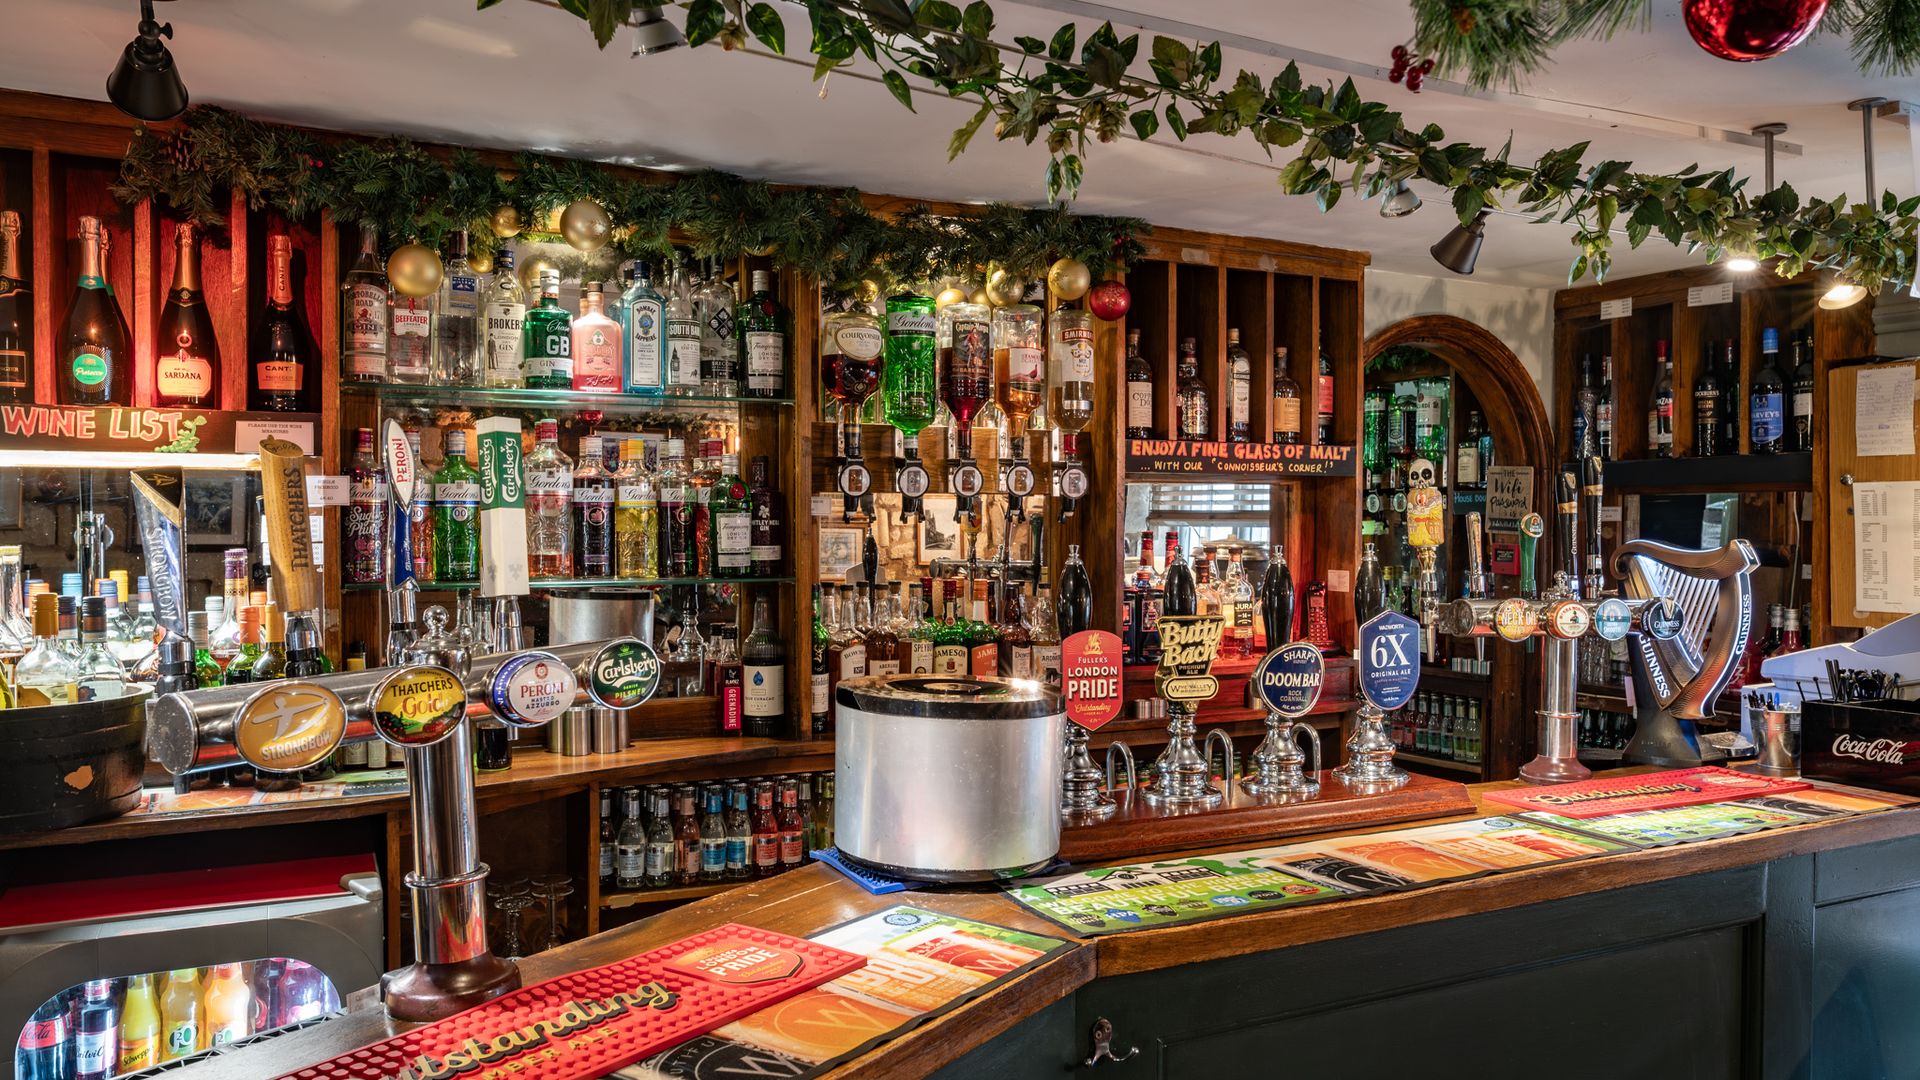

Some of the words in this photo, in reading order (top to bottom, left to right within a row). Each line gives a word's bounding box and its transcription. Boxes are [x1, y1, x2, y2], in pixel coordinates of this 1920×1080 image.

[395, 314, 428, 324] BEEFEATER
[894, 315, 935, 329] Gordon's
[669, 324, 690, 336] SOUTH
[546, 335, 570, 356] GB
[540, 358, 556, 367] GIN
[164, 371, 202, 380] SARDANA
[2, 405, 97, 438] WINE
[109, 408, 183, 442] LIST
[392, 438, 408, 484] PERONI
[1131, 440, 1177, 457] ENJOY
[1176, 441, 1188, 457] A
[1191, 441, 1228, 459] FINE
[1234, 444, 1281, 460] GLASS
[1284, 445, 1304, 460] OF
[1310, 445, 1352, 461] MALT
[480, 438, 496, 505] Carlsberg
[501, 436, 522, 503] Carlsberg
[1154, 459, 1180, 471] WITH
[1183, 461, 1203, 471] OUR
[529, 473, 571, 489] Gordon's
[1494, 478, 1523, 495] Wifi
[284, 467, 309, 571] THATCHERS
[145, 527, 178, 621] STRONGBOW
[1501, 611, 1524, 626] NECK
[1525, 611, 1537, 626] OIL
[1654, 619, 1680, 629] GUINNESS
[1736, 593, 1750, 655] GUINNESS
[1160, 619, 1225, 647] Butty
[934, 646, 966, 659] JAMESON
[976, 647, 997, 659] JAME
[1078, 656, 1108, 664] FULLER'S
[1161, 641, 1218, 667] Bach
[1283, 649, 1317, 663] SHARP'S
[1371, 633, 1410, 669] 6X
[597, 652, 658, 686] Carlsberg
[1067, 666, 1118, 677] LONDON
[1370, 670, 1400, 678] ORIGINAL
[1638, 634, 1671, 699] GUINNESS
[390, 677, 454, 698] THATCHERS
[1068, 679, 1118, 700] PRIDE
[1265, 671, 1303, 687] DOOM
[1302, 672, 1320, 687] BAR
[520, 681, 565, 699] PERONI
[530, 694, 555, 702] NASTRO
[614, 687, 646, 699] PILSNER
[525, 699, 561, 710] AZZURRO
[728, 688, 737, 728] GRENADINE
[261, 730, 332, 761] STRONGBOW
[1832, 734, 1908, 765] Coca-Cola
[1535, 781, 1698, 806] Outstanding
[1045, 892, 1137, 909] WELCOME
[1140, 887, 1158, 897] TO
[1163, 883, 1200, 894] THE
[1049, 889, 1203, 916] BEAUTIFUL
[1206, 873, 1295, 894] BEERS
[695, 946, 760, 970] LONDON
[708, 949, 781, 977] PRIDE
[481, 1047, 562, 1080] MBER
[567, 1026, 620, 1050] ALE
